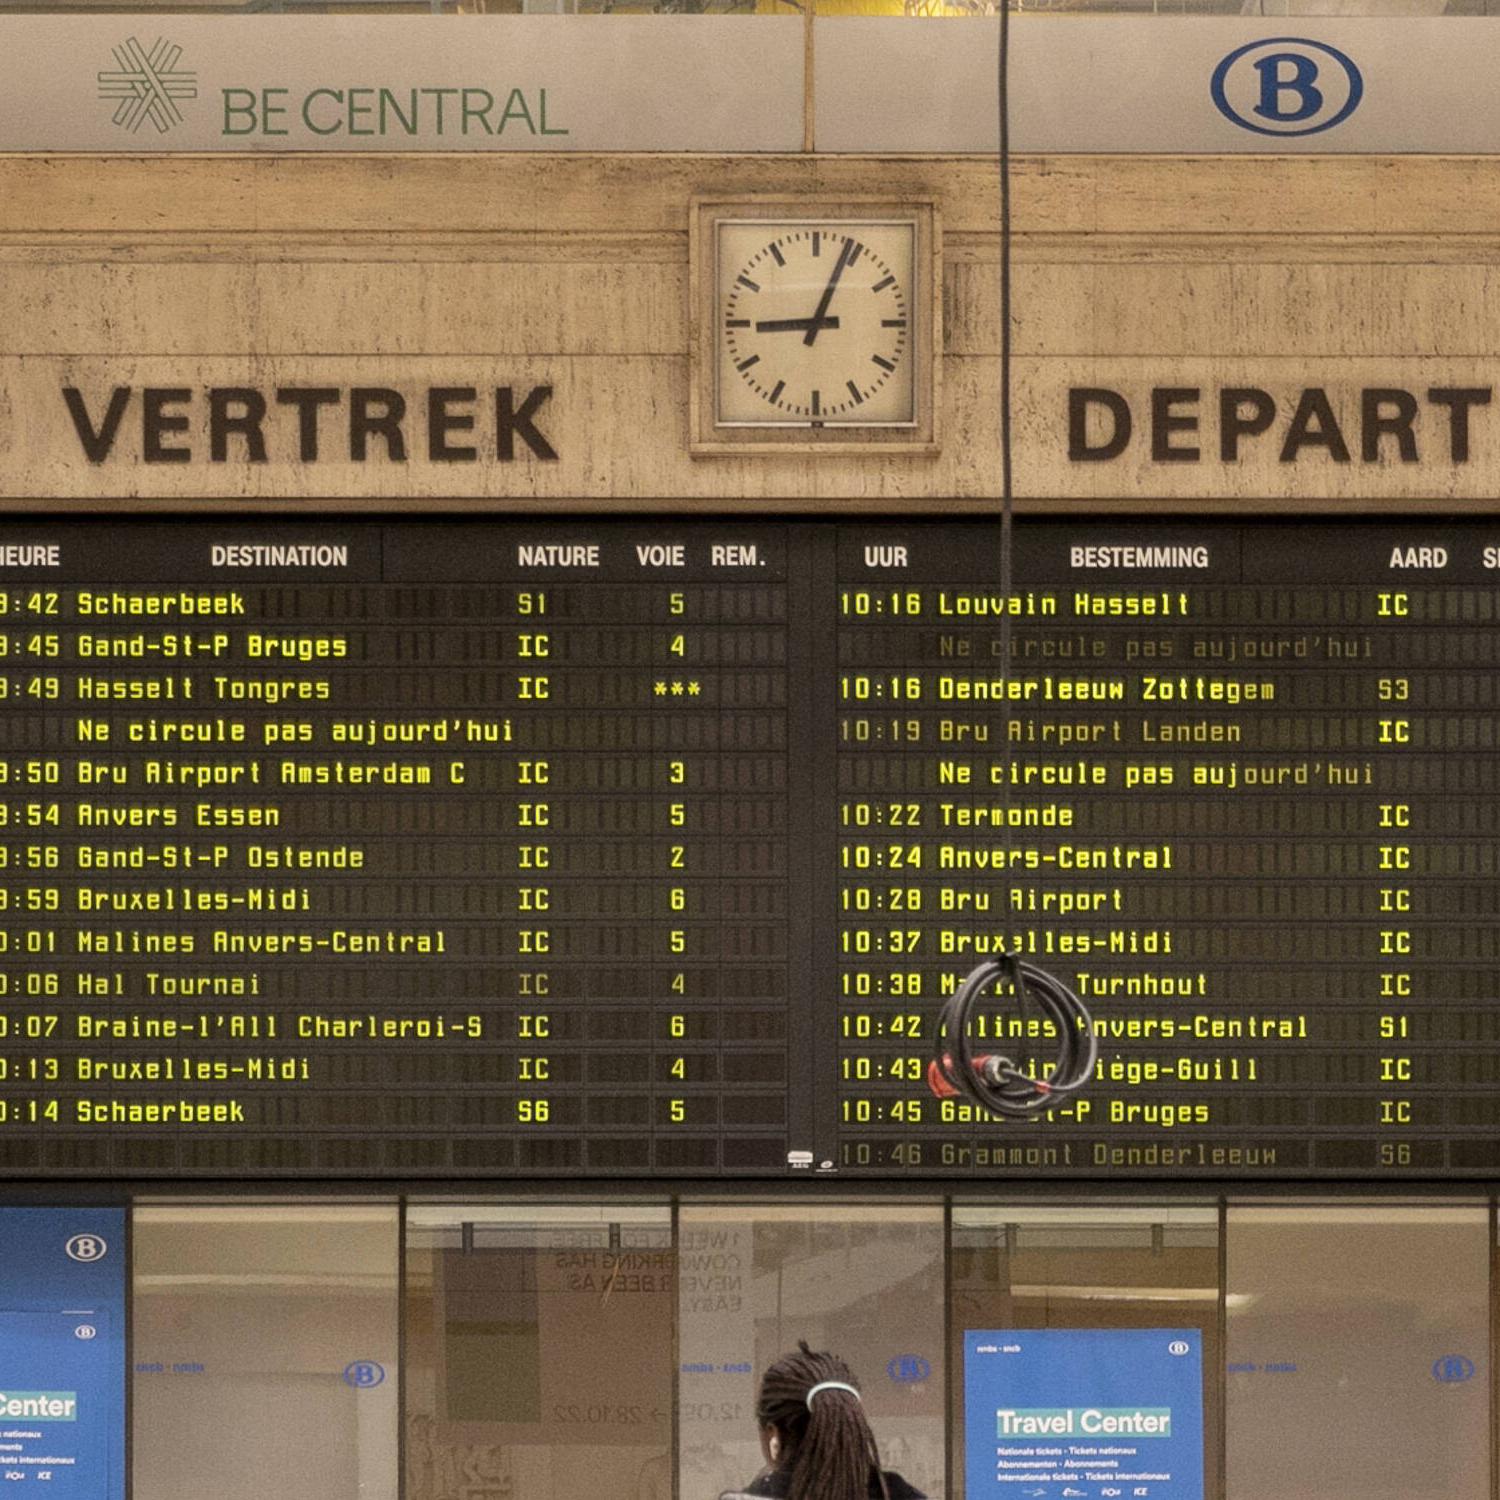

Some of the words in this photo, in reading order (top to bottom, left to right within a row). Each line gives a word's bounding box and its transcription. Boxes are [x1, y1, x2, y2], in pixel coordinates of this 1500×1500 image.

[1252, 53, 1324, 122] B
[221, 87, 292, 136] BE
[301, 86, 570, 136] CENTRAL
[61, 384, 559, 466] VERTREK
[1067, 386, 1493, 465] DEPART
[211, 545, 348, 567] DESTINATION
[518, 545, 600, 567] NATURE
[636, 545, 685, 567] VOIE
[711, 545, 766, 566] REM.
[864, 545, 908, 568] UUR
[1070, 546, 1209, 568] BESTEMMING
[1389, 547, 1448, 569] AARD
[77, 633, 229, 658] Gand-St-P
[247, 633, 346, 662] Bruges
[517, 633, 548, 658] IC
[669, 634, 685, 655] 4
[840, 676, 922, 701] 10:16
[938, 676, 1124, 700] Denderleeuw
[1142, 675, 1274, 704] Zottegem
[1377, 678, 1409, 701] S3
[77, 719, 109, 742] Ne
[127, 719, 245, 742] circule
[263, 722, 312, 744] pas
[77, 760, 127, 785] Bru
[144, 760, 259, 787] Airport
[280, 760, 431, 785] Amsterdam
[449, 761, 464, 785] C
[517, 760, 548, 785] IC
[669, 761, 685, 784] 3
[841, 844, 922, 869] 10:24
[938, 844, 1171, 869] Anvers-Central
[1378, 845, 1409, 870] IC
[996, 1409, 1073, 1434] Travel
[1080, 1409, 1170, 1433] Center
